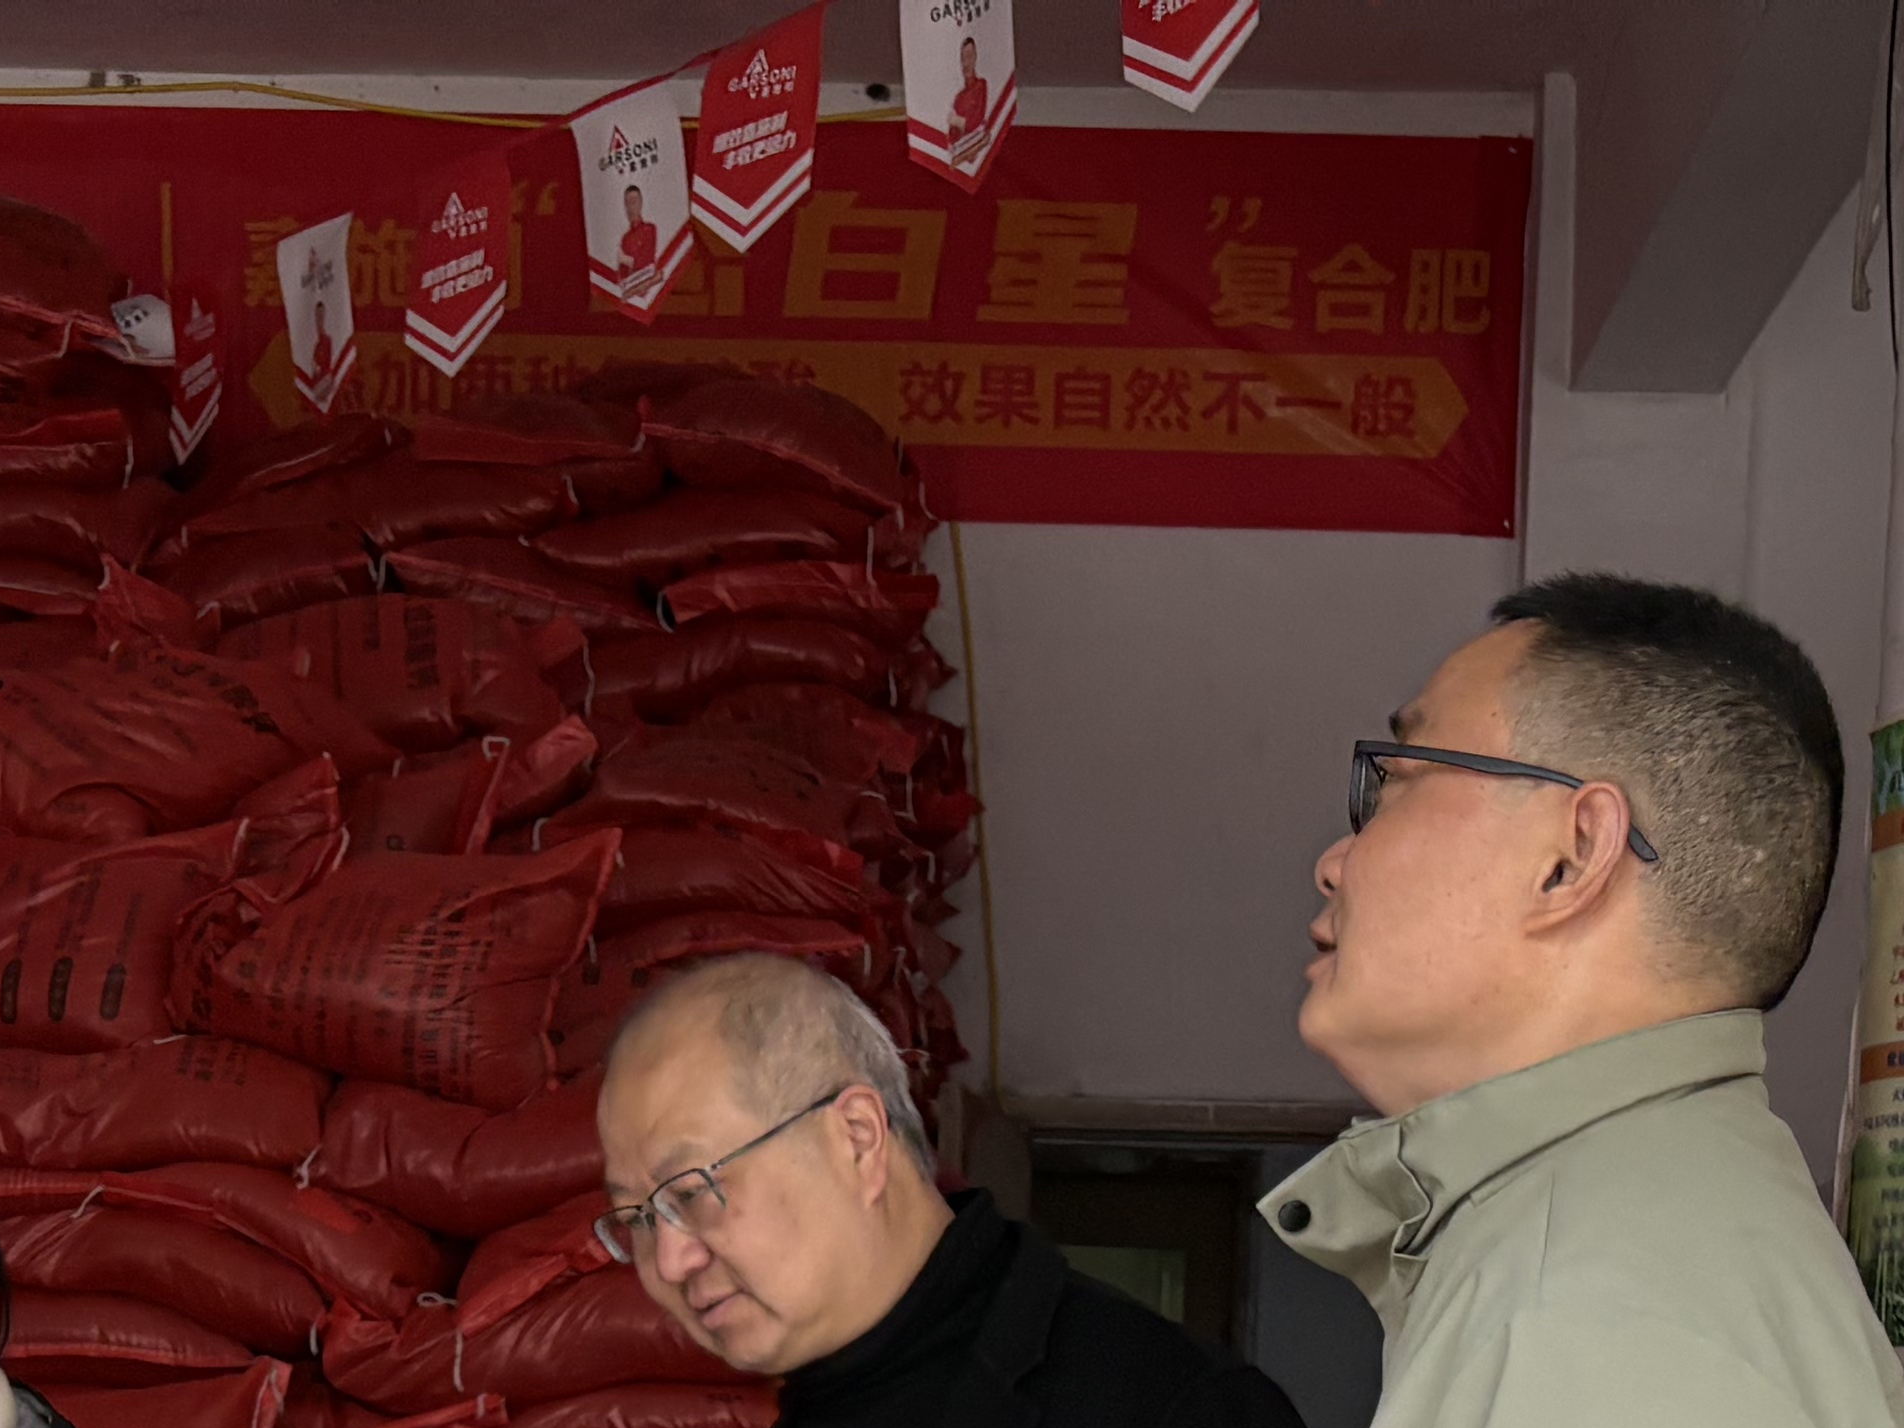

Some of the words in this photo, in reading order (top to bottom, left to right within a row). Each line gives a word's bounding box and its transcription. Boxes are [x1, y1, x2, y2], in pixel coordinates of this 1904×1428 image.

[1210, 241, 1490, 336] 复合肥
[896, 359, 1419, 438] 效果自然不一般
